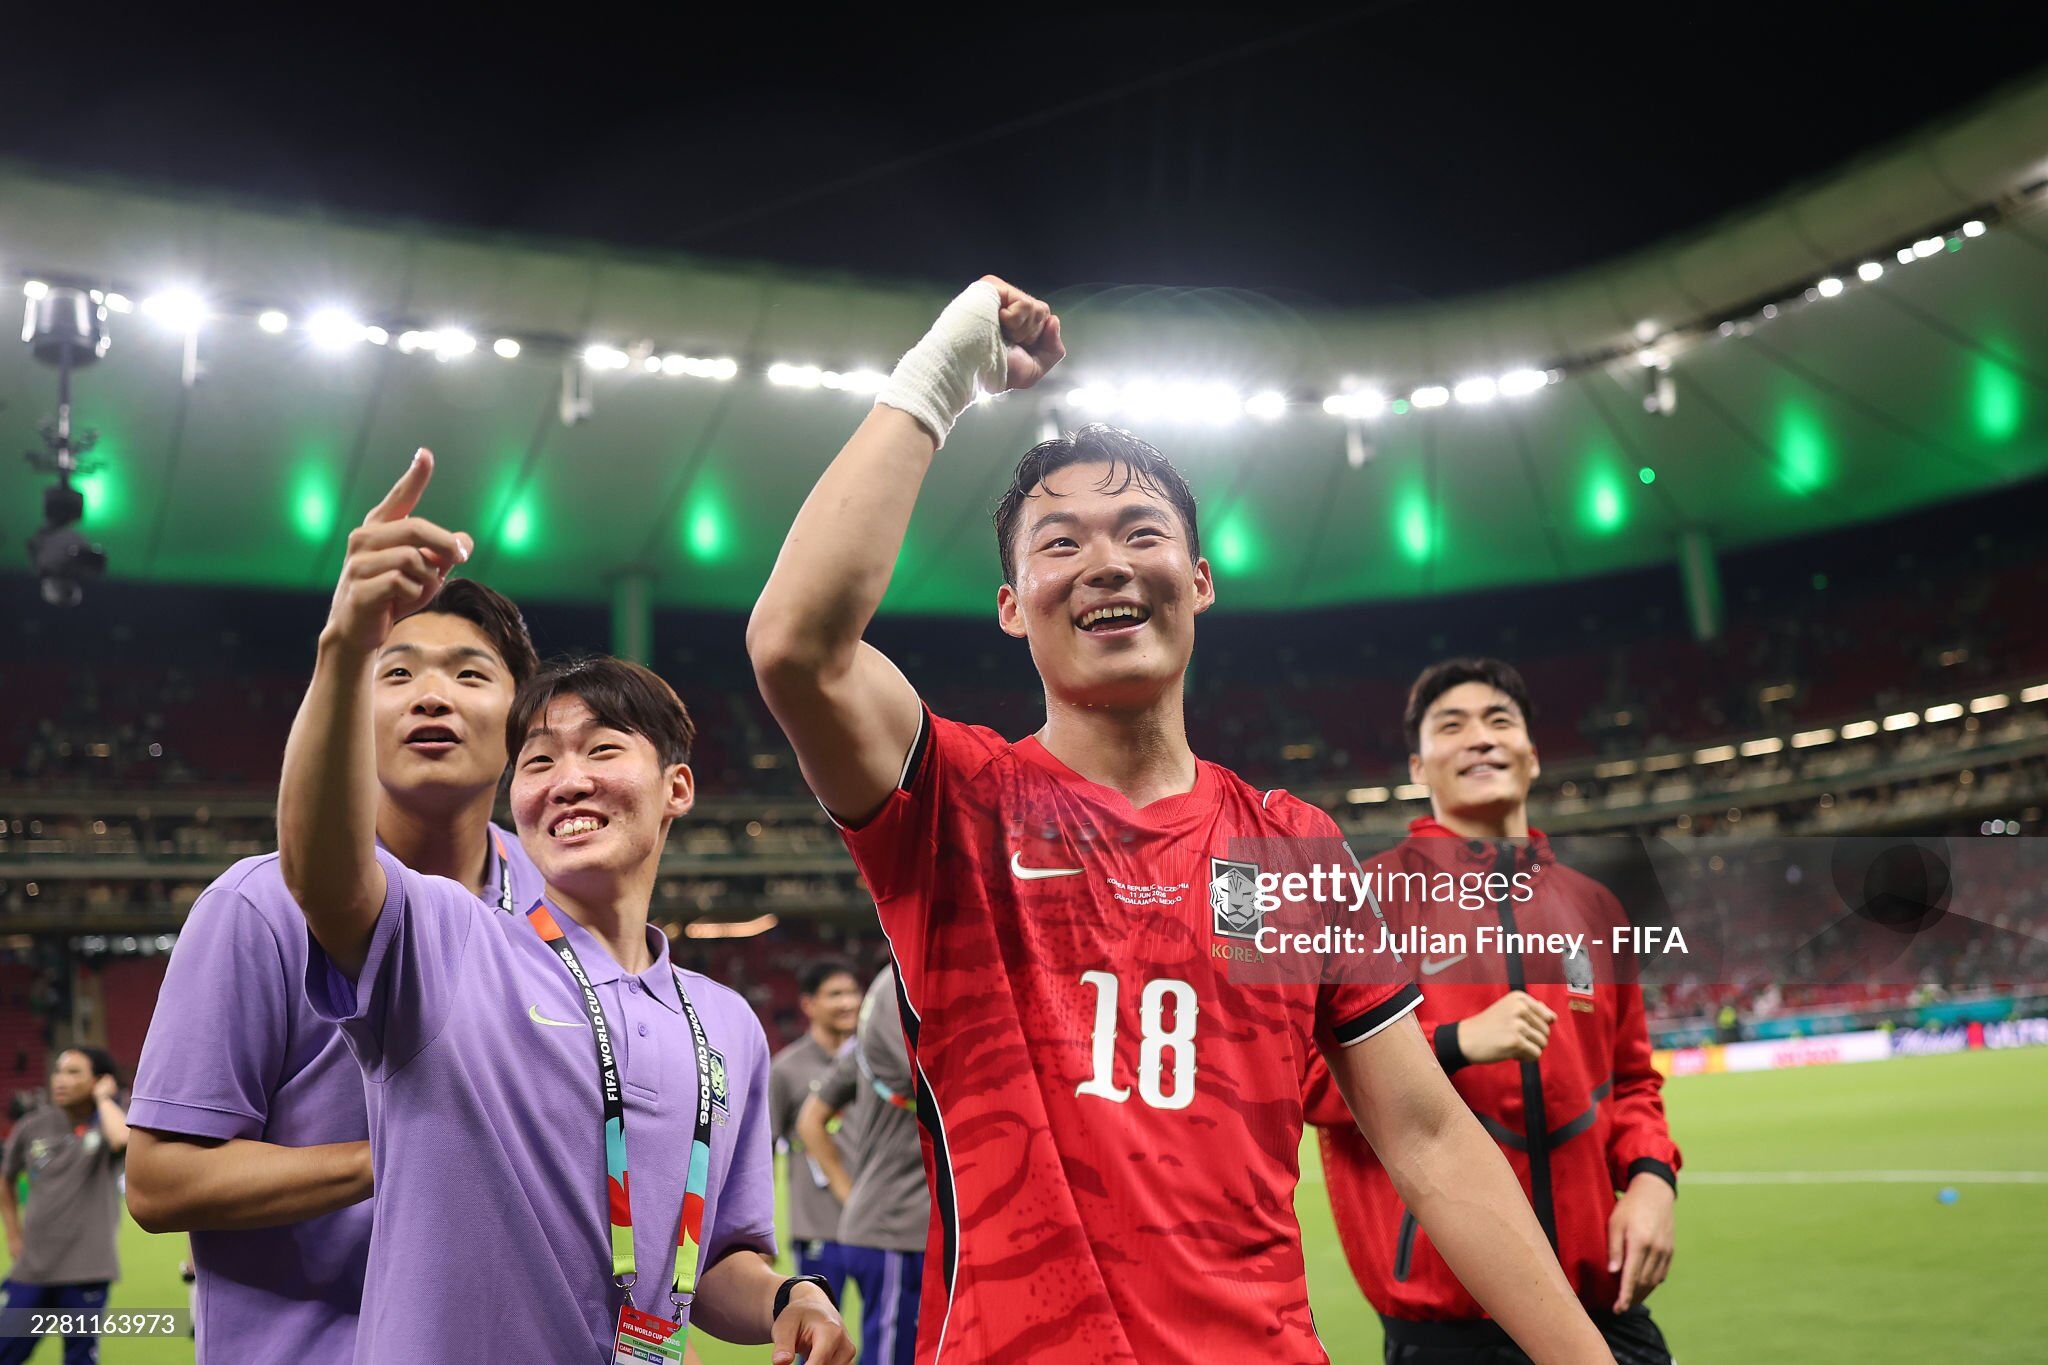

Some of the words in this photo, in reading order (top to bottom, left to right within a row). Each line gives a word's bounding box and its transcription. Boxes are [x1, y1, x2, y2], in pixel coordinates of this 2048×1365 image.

[1212, 943, 1264, 964] KOREA
[585, 988, 601, 1014] CUP
[593, 1015, 613, 1067] WORLD
[685, 1005, 706, 1046] WORLD
[1074, 969, 1200, 1110] 18
[697, 1046, 709, 1073] CUP
[604, 1069, 618, 1101] FIFA
[699, 1073, 710, 1125] 2026
[623, 1322, 634, 1331] FIFA
[634, 1326, 652, 1337] WORLD
[652, 1332, 663, 1341] CUP
